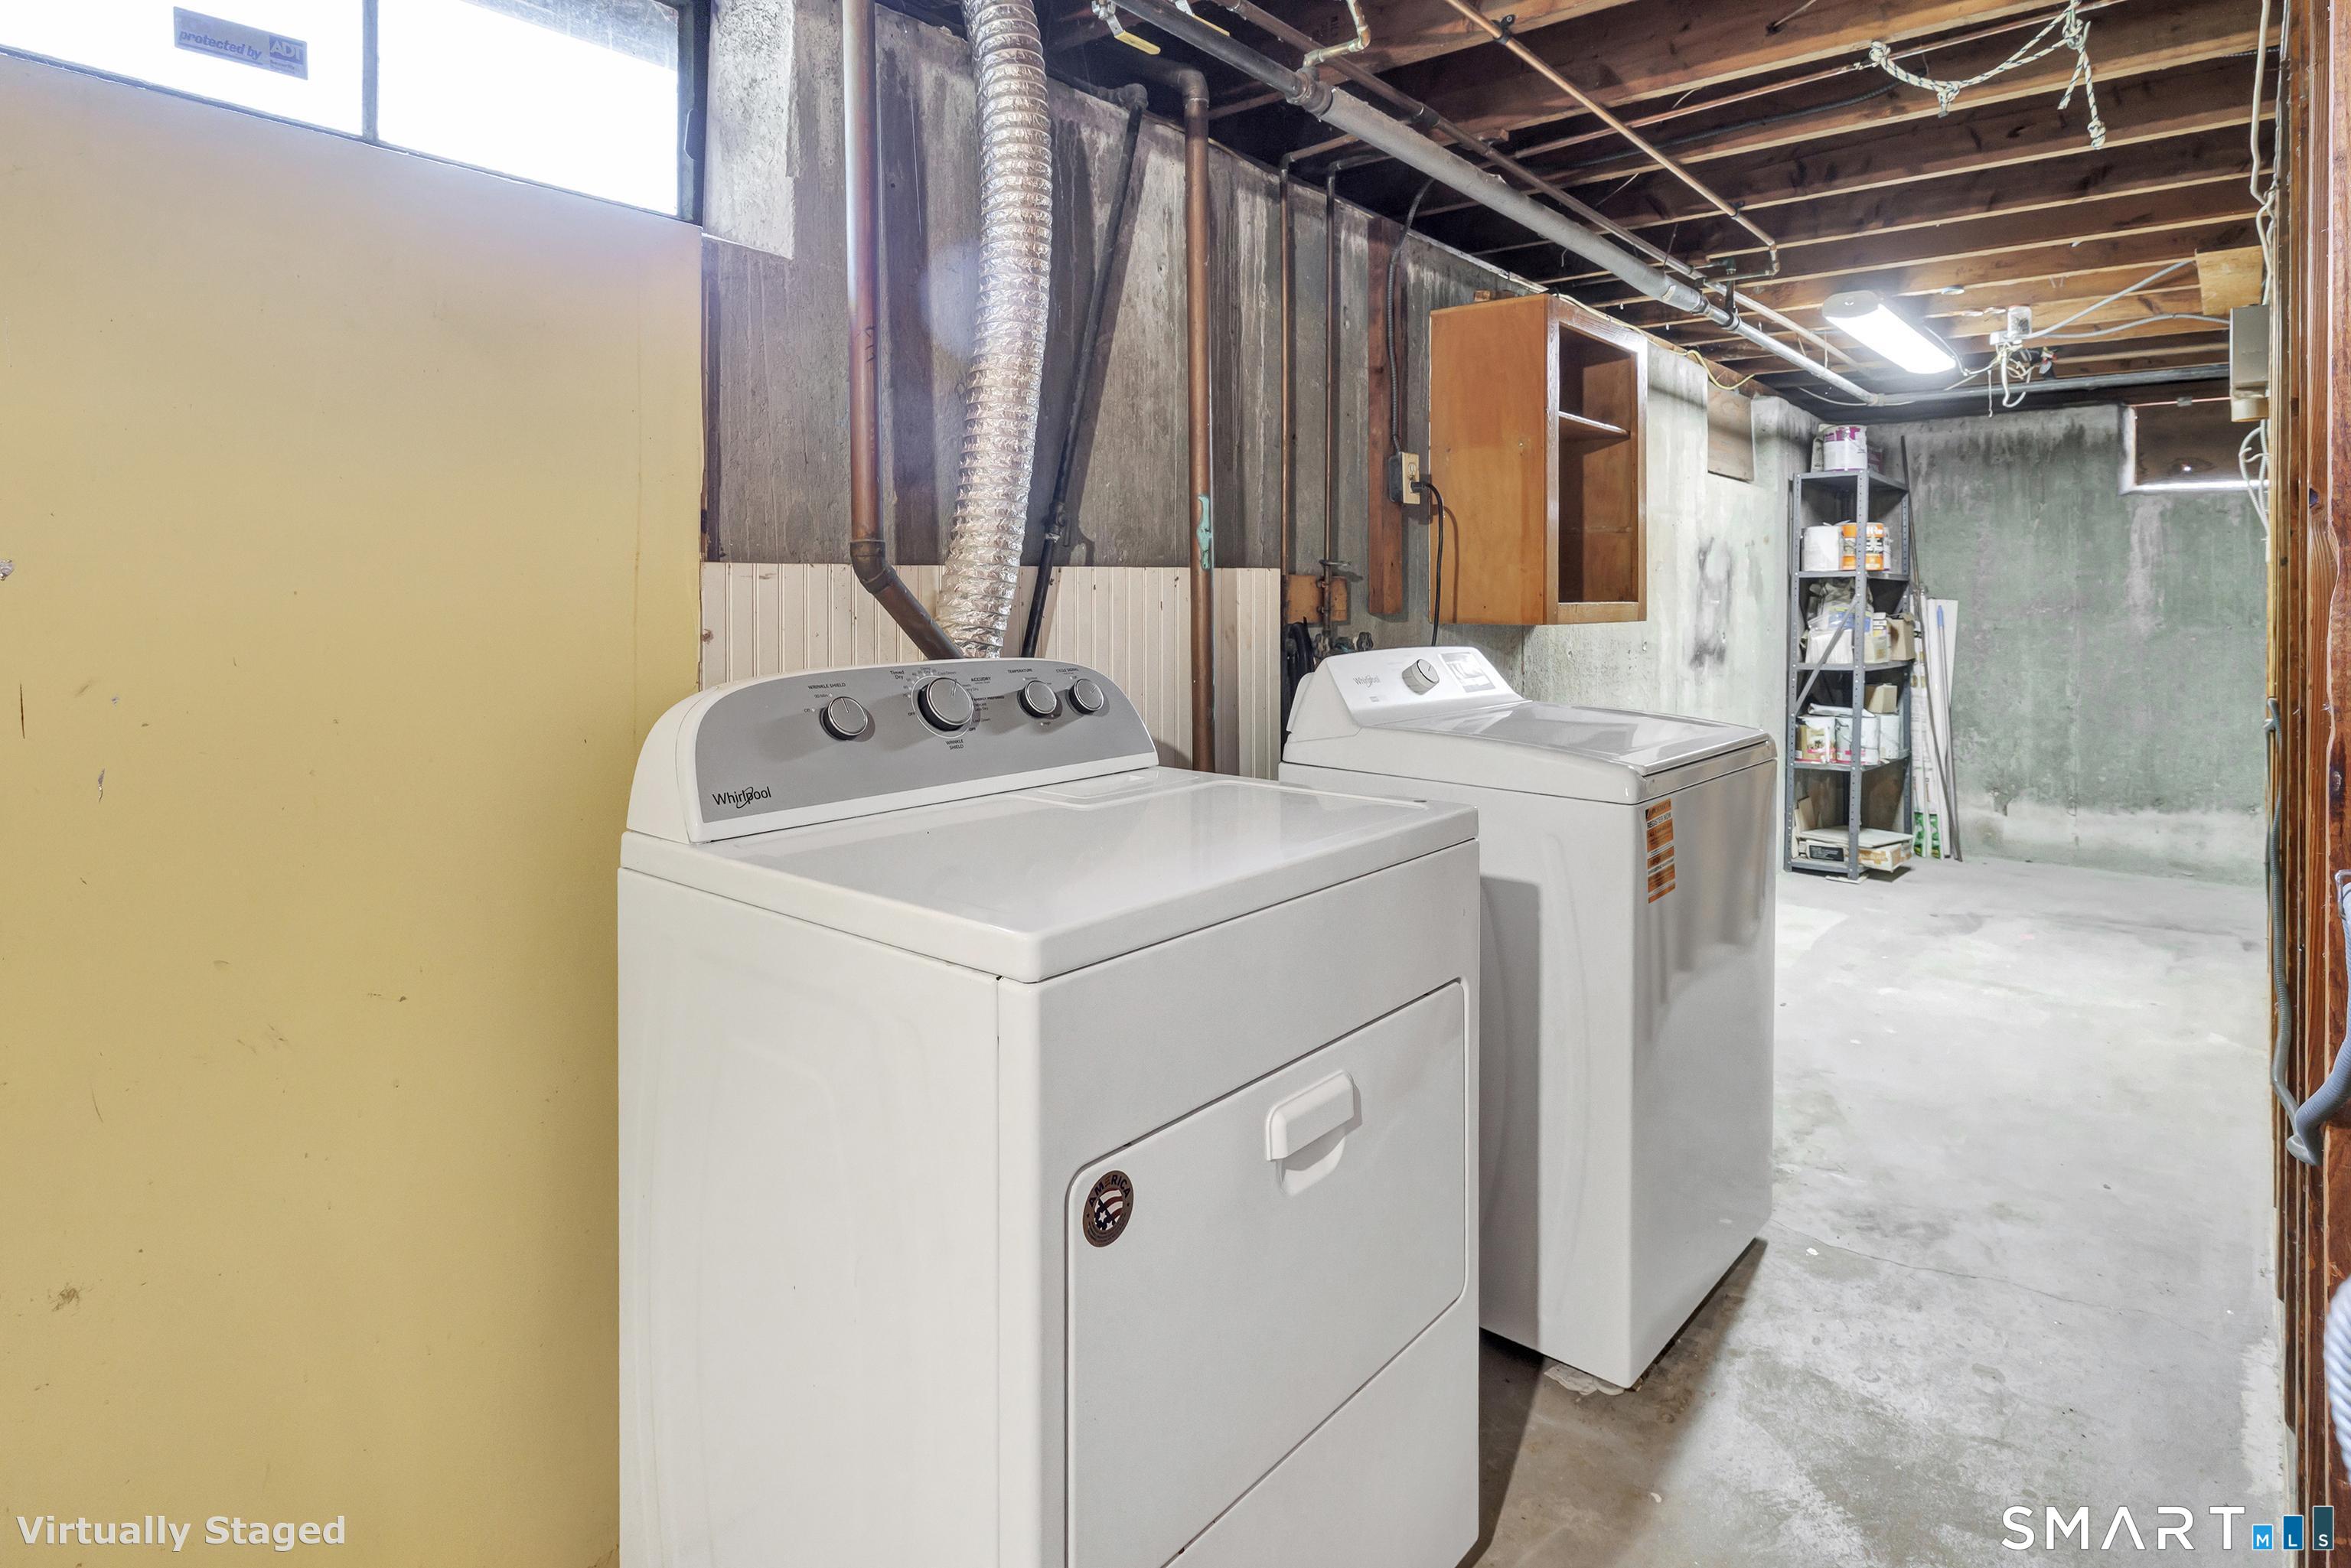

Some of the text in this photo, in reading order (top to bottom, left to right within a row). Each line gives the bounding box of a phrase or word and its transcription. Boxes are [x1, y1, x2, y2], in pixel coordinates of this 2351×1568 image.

[179, 31, 302, 60] protected by ADT
[1353, 674, 1381, 688] Whirlpool
[712, 786, 772, 809] Whirlpool
[1088, 1174, 1130, 1207] AMERICA
